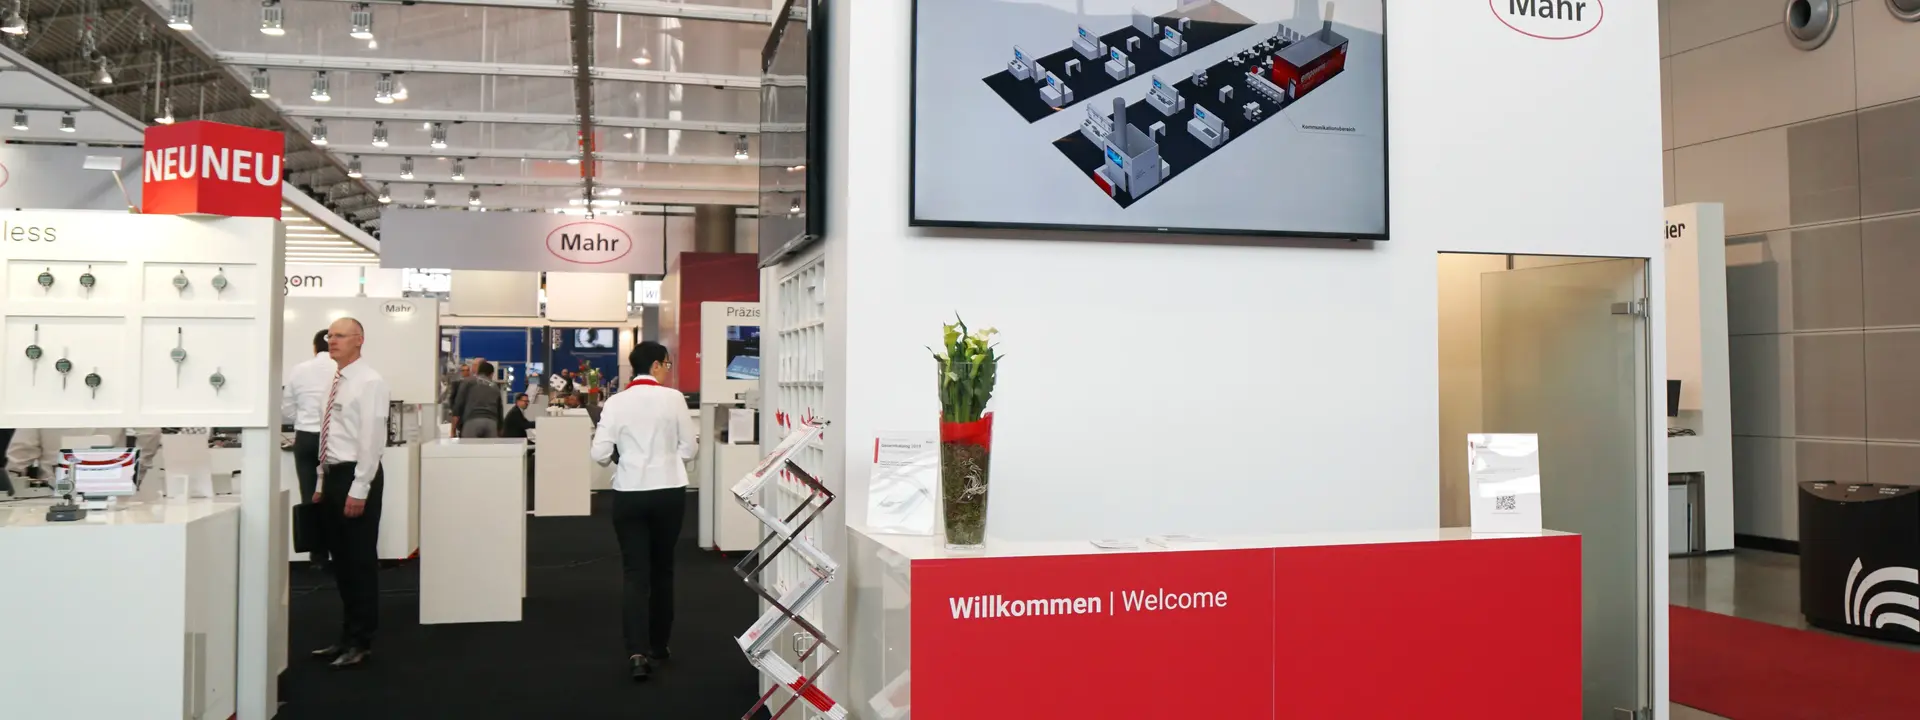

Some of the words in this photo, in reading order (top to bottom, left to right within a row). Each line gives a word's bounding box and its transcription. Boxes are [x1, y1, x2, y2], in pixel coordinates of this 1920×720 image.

[144, 144, 197, 183] NEU
[201, 145, 281, 186] NEU
[1664, 220, 1686, 239] ier
[560, 233, 620, 252] Mahr
[385, 304, 412, 313] Mahr
[949, 594, 1102, 620] Willkommen
[1121, 588, 1228, 612] Welcome
